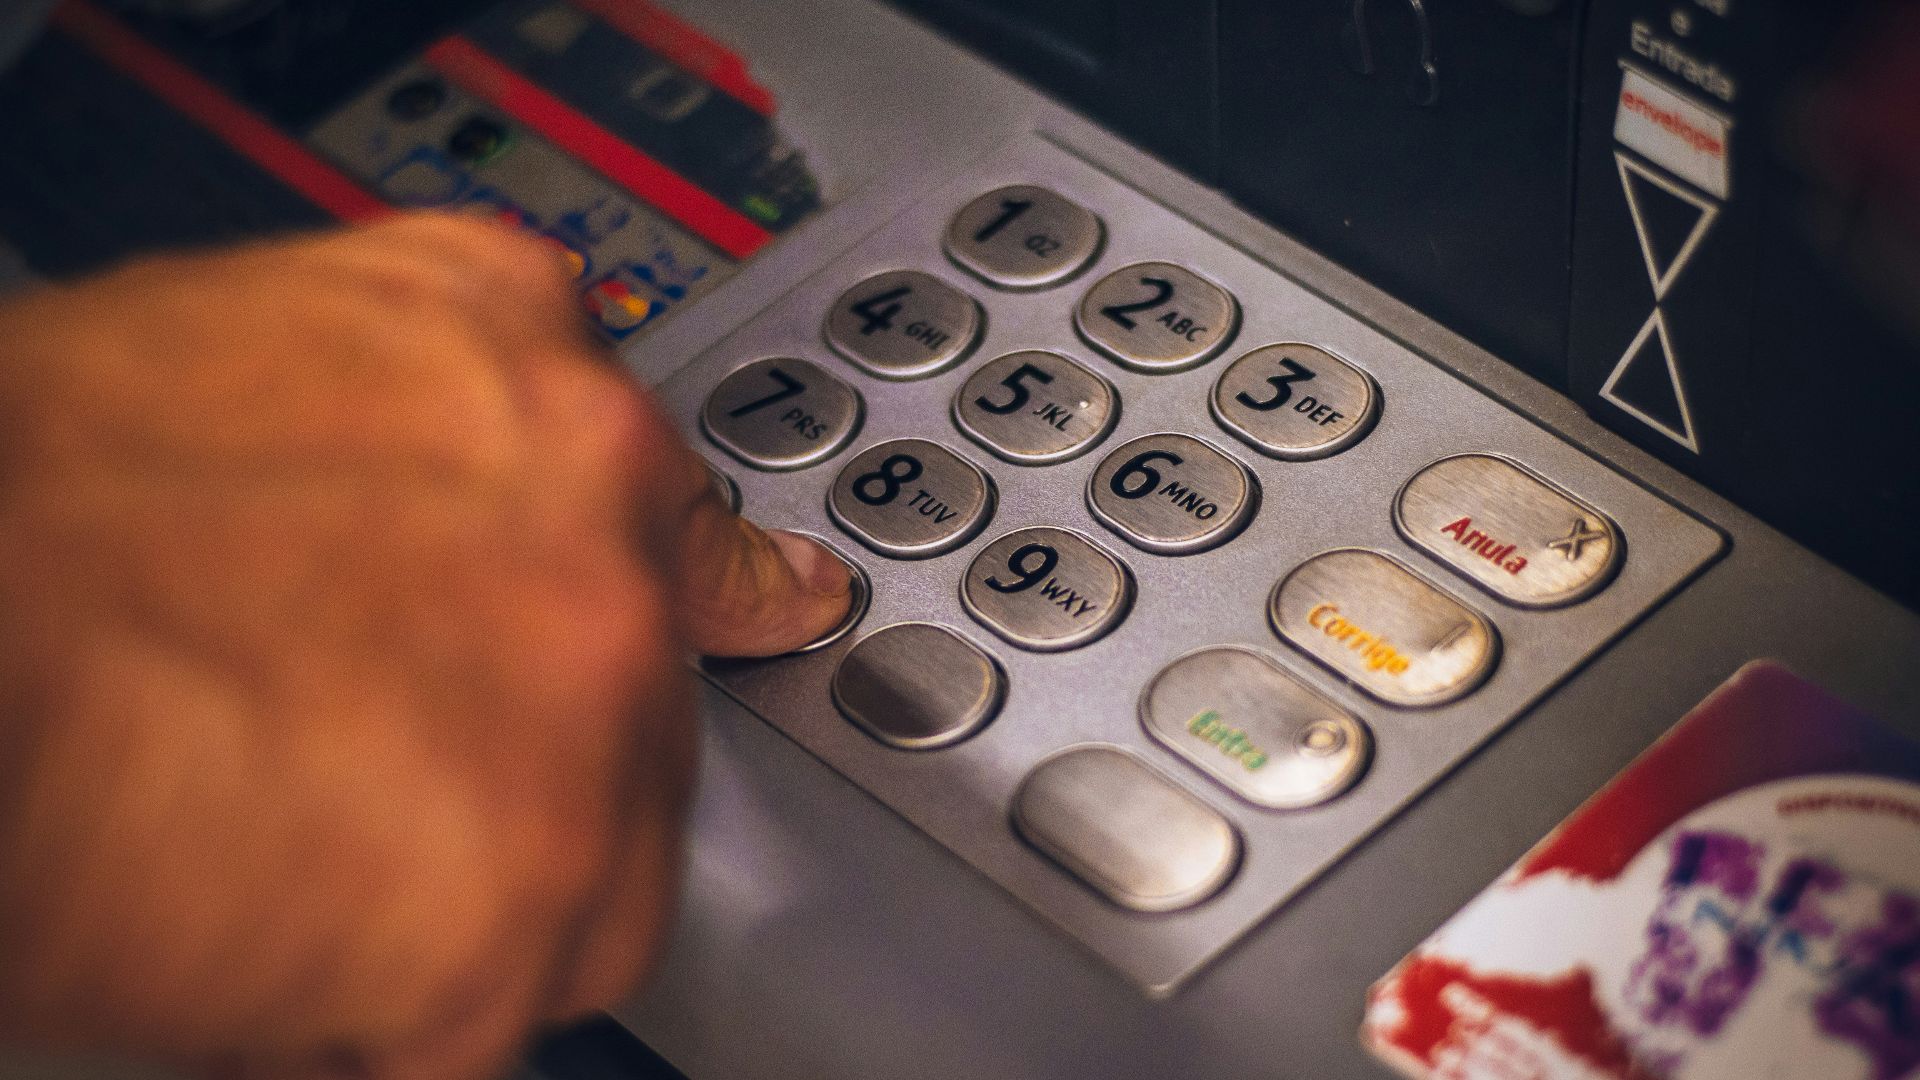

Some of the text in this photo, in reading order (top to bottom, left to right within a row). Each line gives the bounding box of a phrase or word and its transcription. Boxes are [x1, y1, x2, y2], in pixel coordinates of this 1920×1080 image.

[1631, 21, 1735, 101] Entrada
[1621, 91, 1721, 158] envelope
[975, 200, 1032, 242] 1
[849, 286, 950, 350] 4 GHI
[1100, 277, 1207, 342] 2 ABC
[728, 368, 827, 440] 7 PRS
[975, 362, 1073, 431] 5 JKL
[1235, 357, 1344, 426] 3 DEF
[852, 453, 958, 523] 8 TUV
[1109, 450, 1218, 521] 6 MNO
[984, 543, 1097, 619] 9 WXY
[1441, 517, 1528, 576] Anula
[1307, 602, 1411, 675] Corrige
[1188, 708, 1267, 772] Entra
